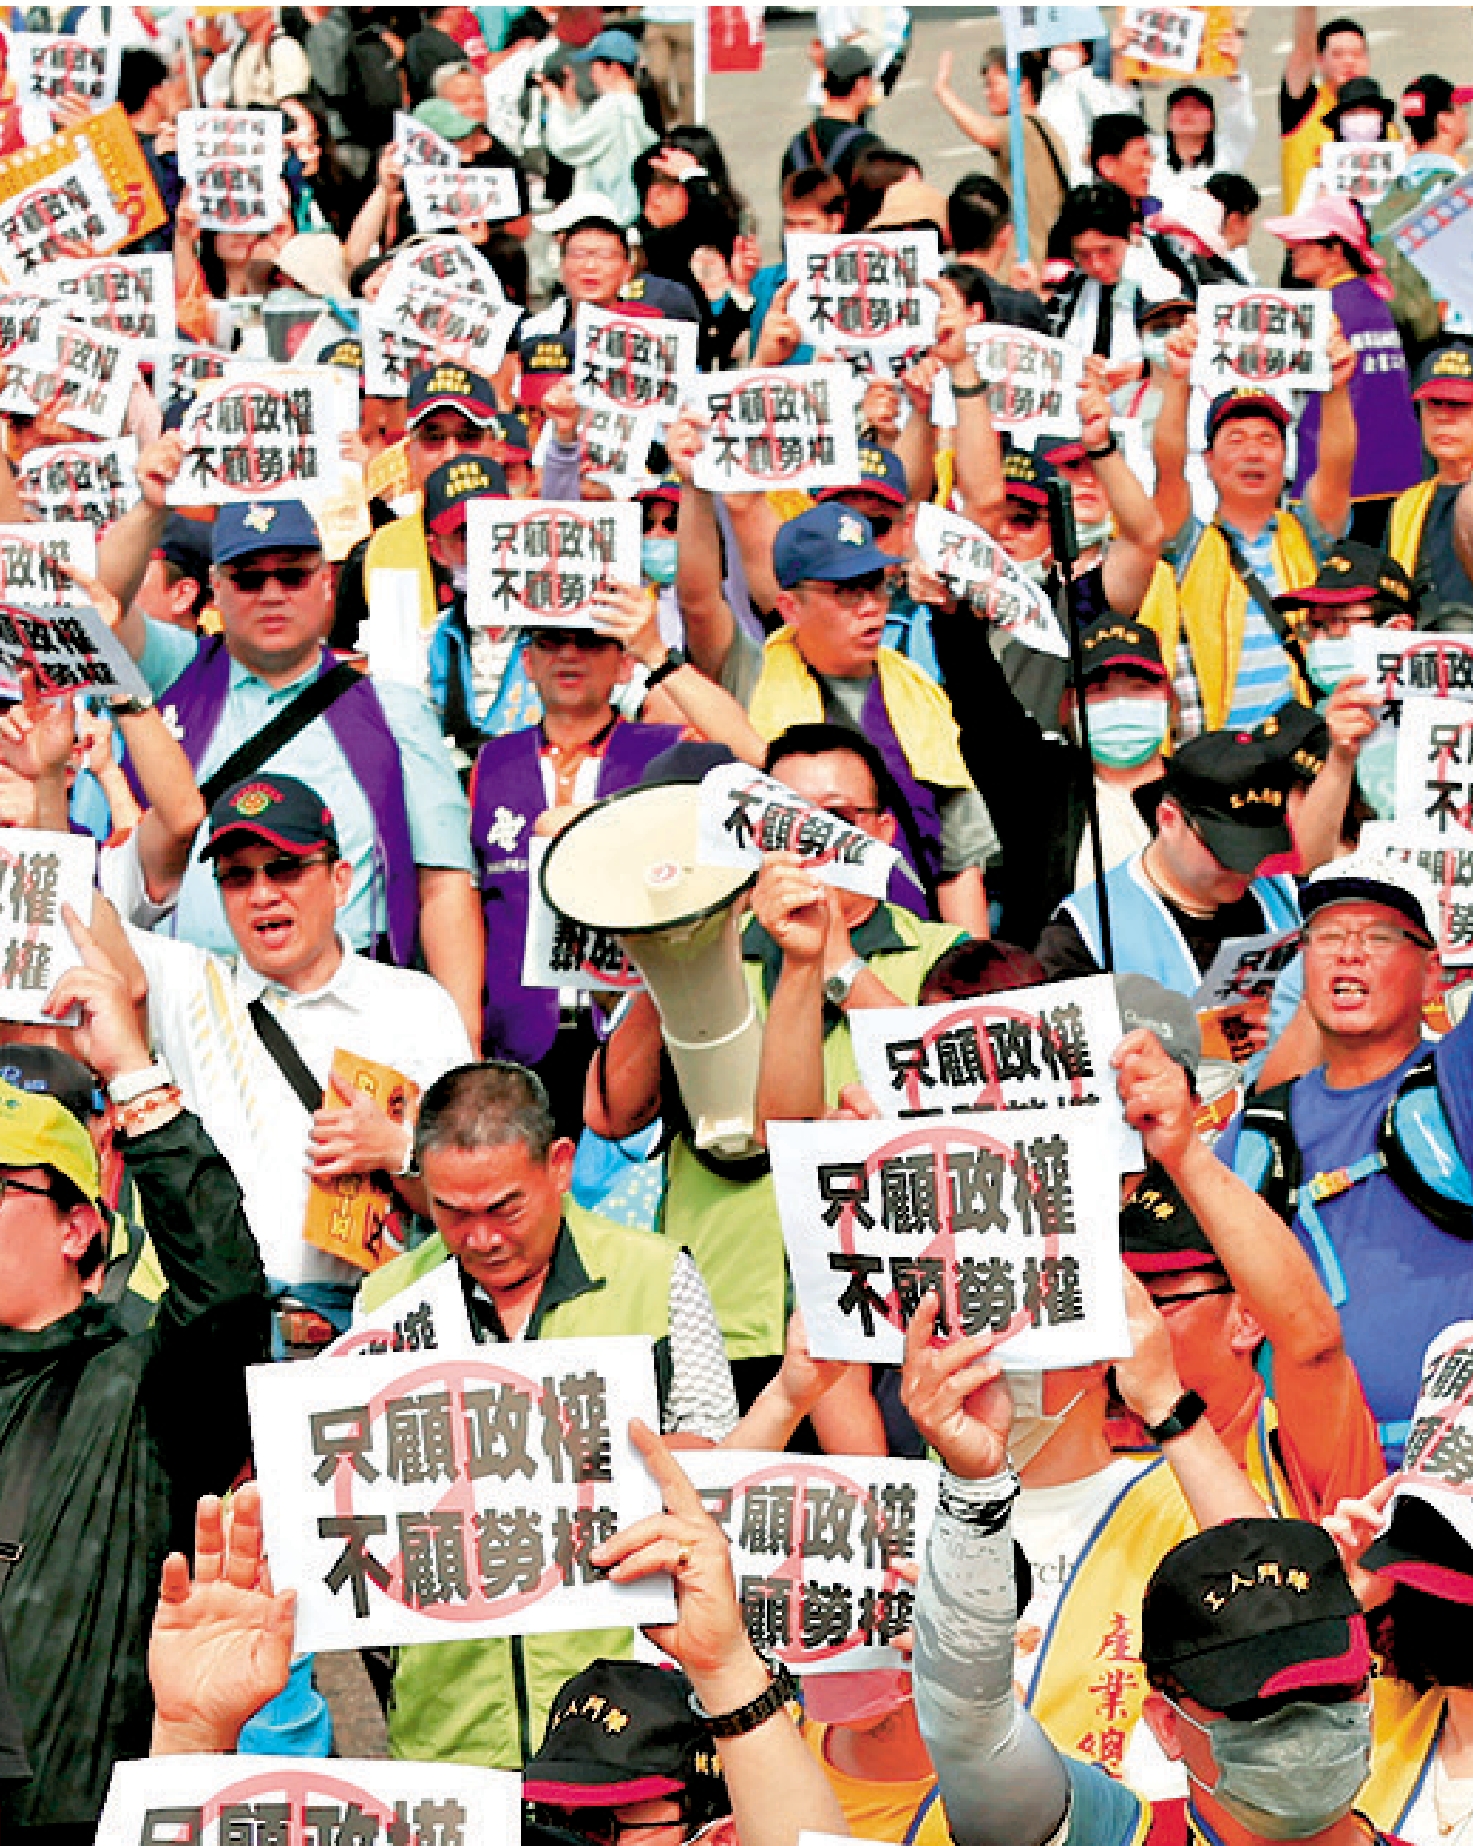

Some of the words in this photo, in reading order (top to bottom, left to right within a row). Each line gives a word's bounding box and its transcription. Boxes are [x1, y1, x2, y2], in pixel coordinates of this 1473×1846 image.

[806, 245, 919, 289] 只顧政權
[809, 294, 922, 334] 不顧勞權
[1212, 301, 1316, 341] 只顧政權
[1210, 342, 1316, 378] 不顧勞權
[187, 389, 316, 441] 只顧政權
[706, 375, 830, 427] 只顧政權
[187, 442, 319, 491] 不顧勞權
[712, 428, 834, 480] 不顧勞權
[490, 522, 617, 562] 只顧政權
[722, 786, 872, 865] 不顧勞權
[885, 1004, 1096, 1090] 只顧政權
[817, 1132, 1078, 1237] 只顧政權
[826, 1253, 1086, 1337] 不顧勞權
[308, 1368, 614, 1489] 只顧政權
[318, 1507, 619, 1618] 不顧勞權
